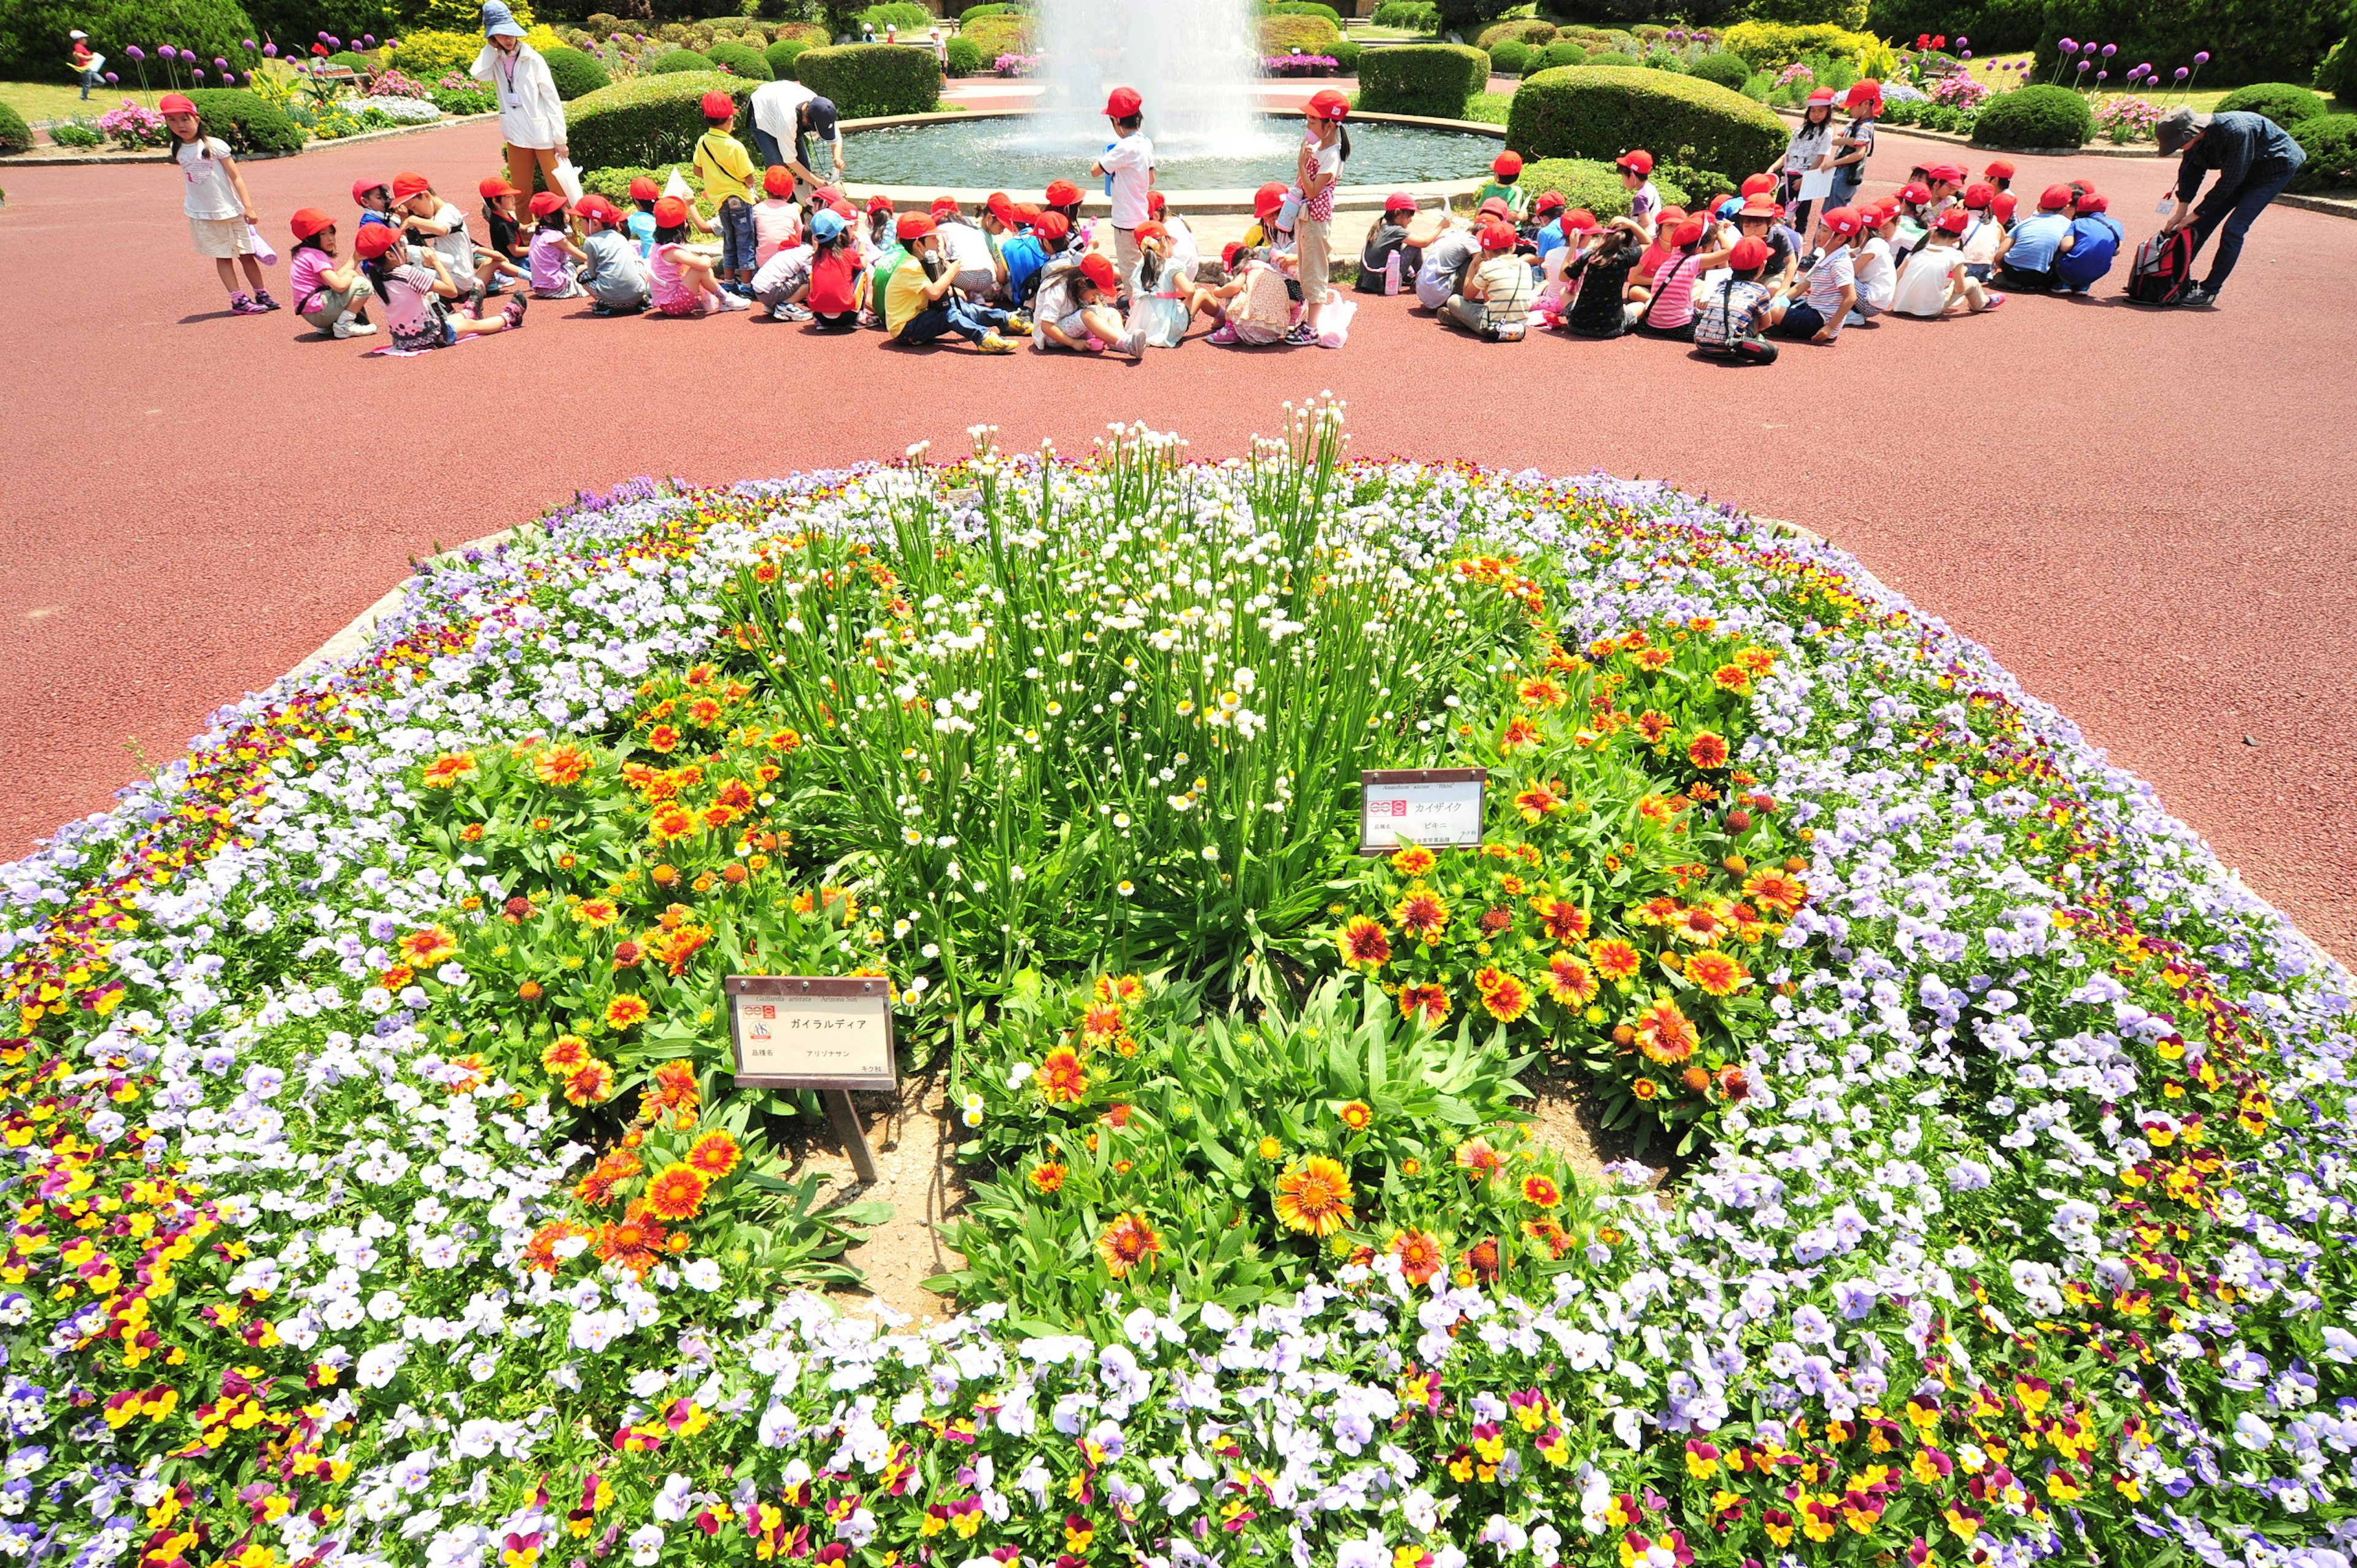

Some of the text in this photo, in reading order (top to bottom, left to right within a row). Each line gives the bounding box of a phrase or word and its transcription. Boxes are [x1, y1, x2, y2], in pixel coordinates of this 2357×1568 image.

[1415, 802, 1461, 813] カイザイク
[791, 1019, 867, 1030] ガイラルディア
